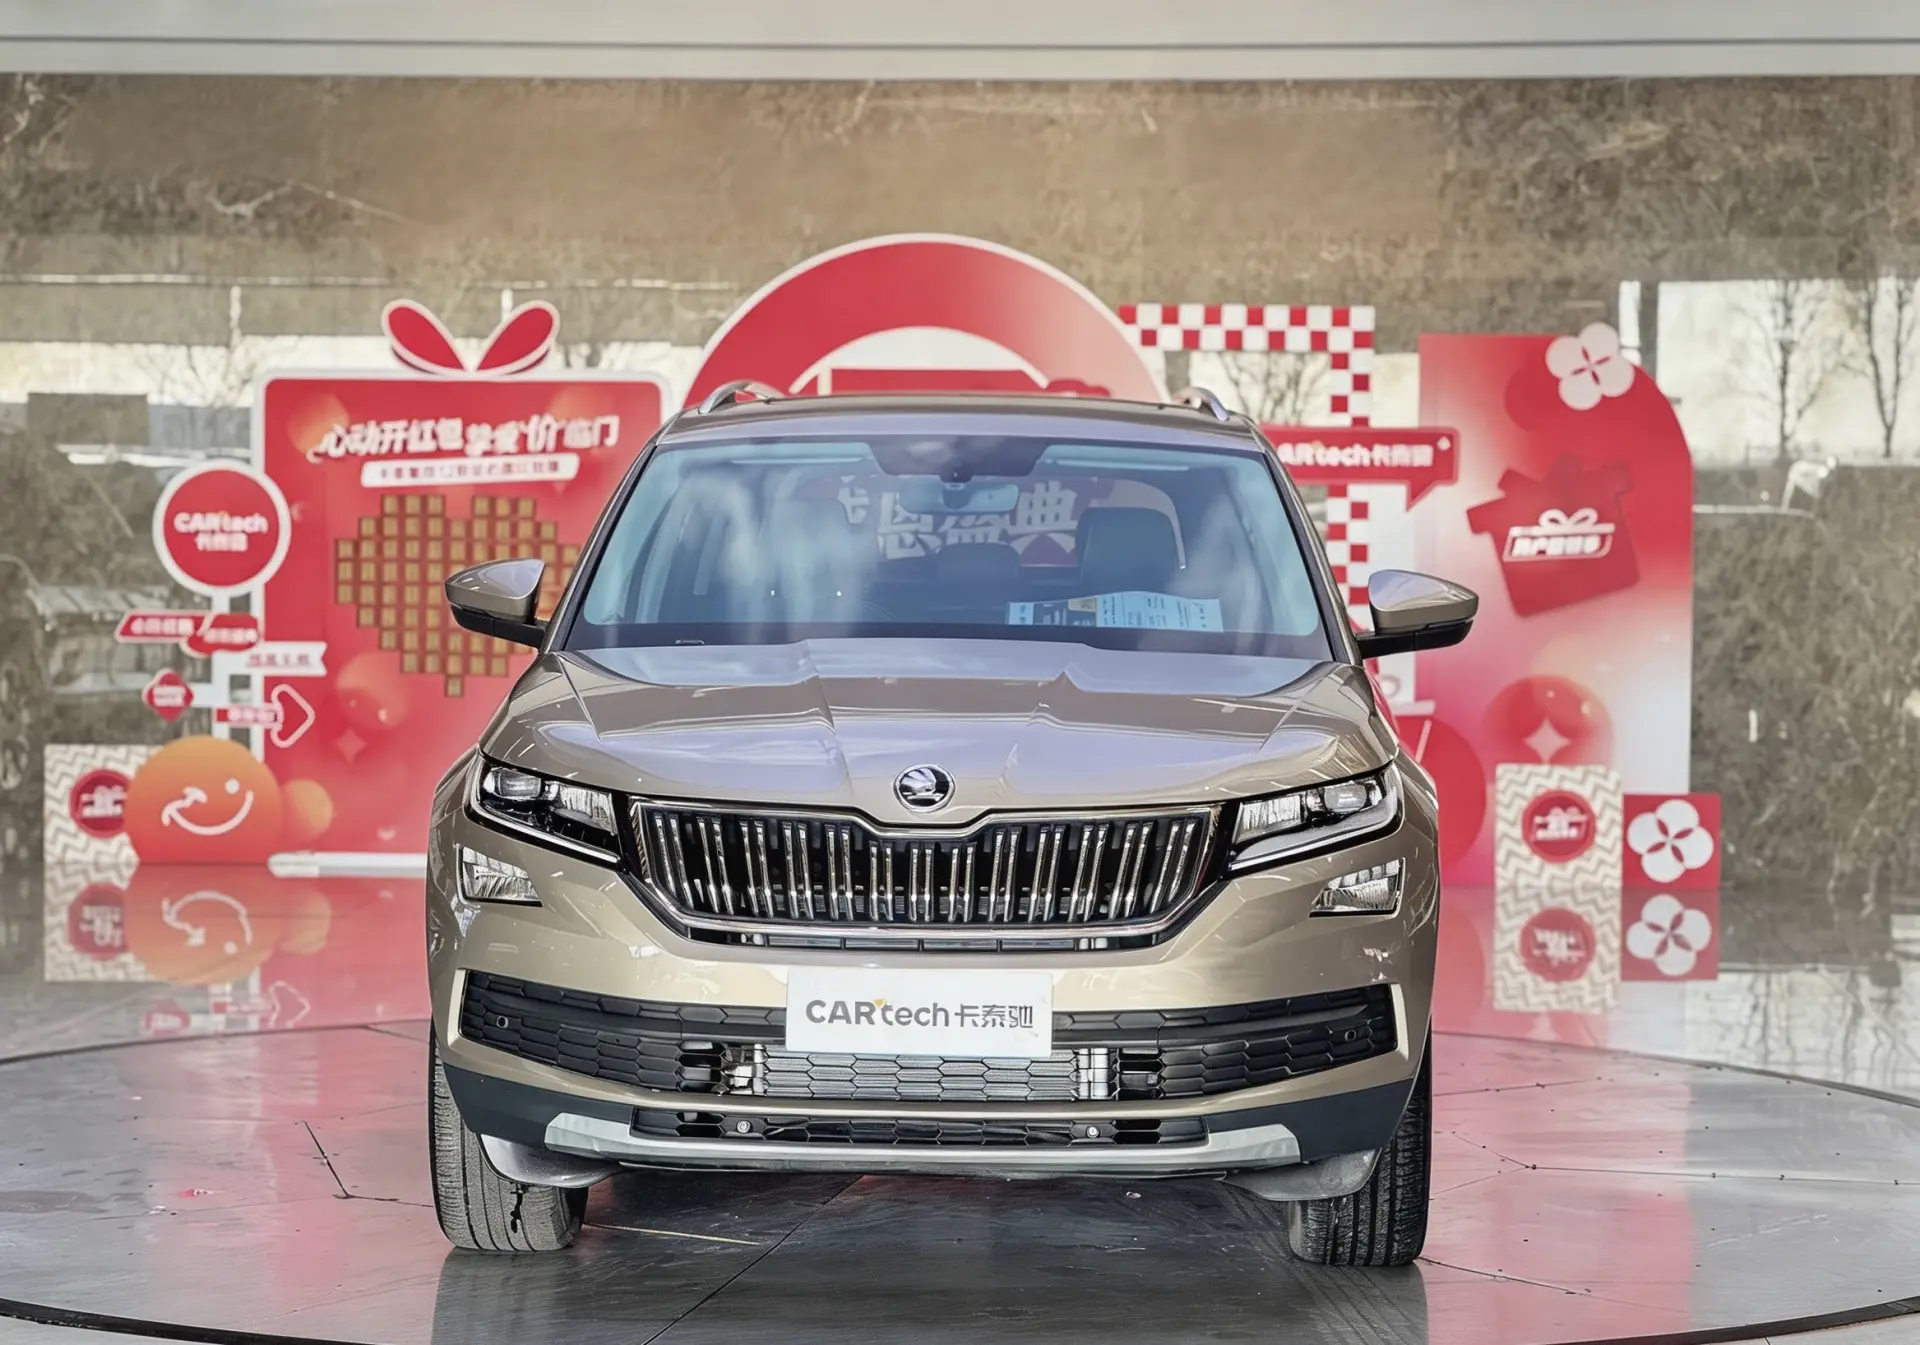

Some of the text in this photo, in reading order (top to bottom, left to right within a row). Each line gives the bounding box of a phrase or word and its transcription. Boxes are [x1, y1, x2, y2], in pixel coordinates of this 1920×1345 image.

[1276, 441, 1370, 467] ARtech
[805, 999, 1034, 1029] CARtech 卡泰驰
